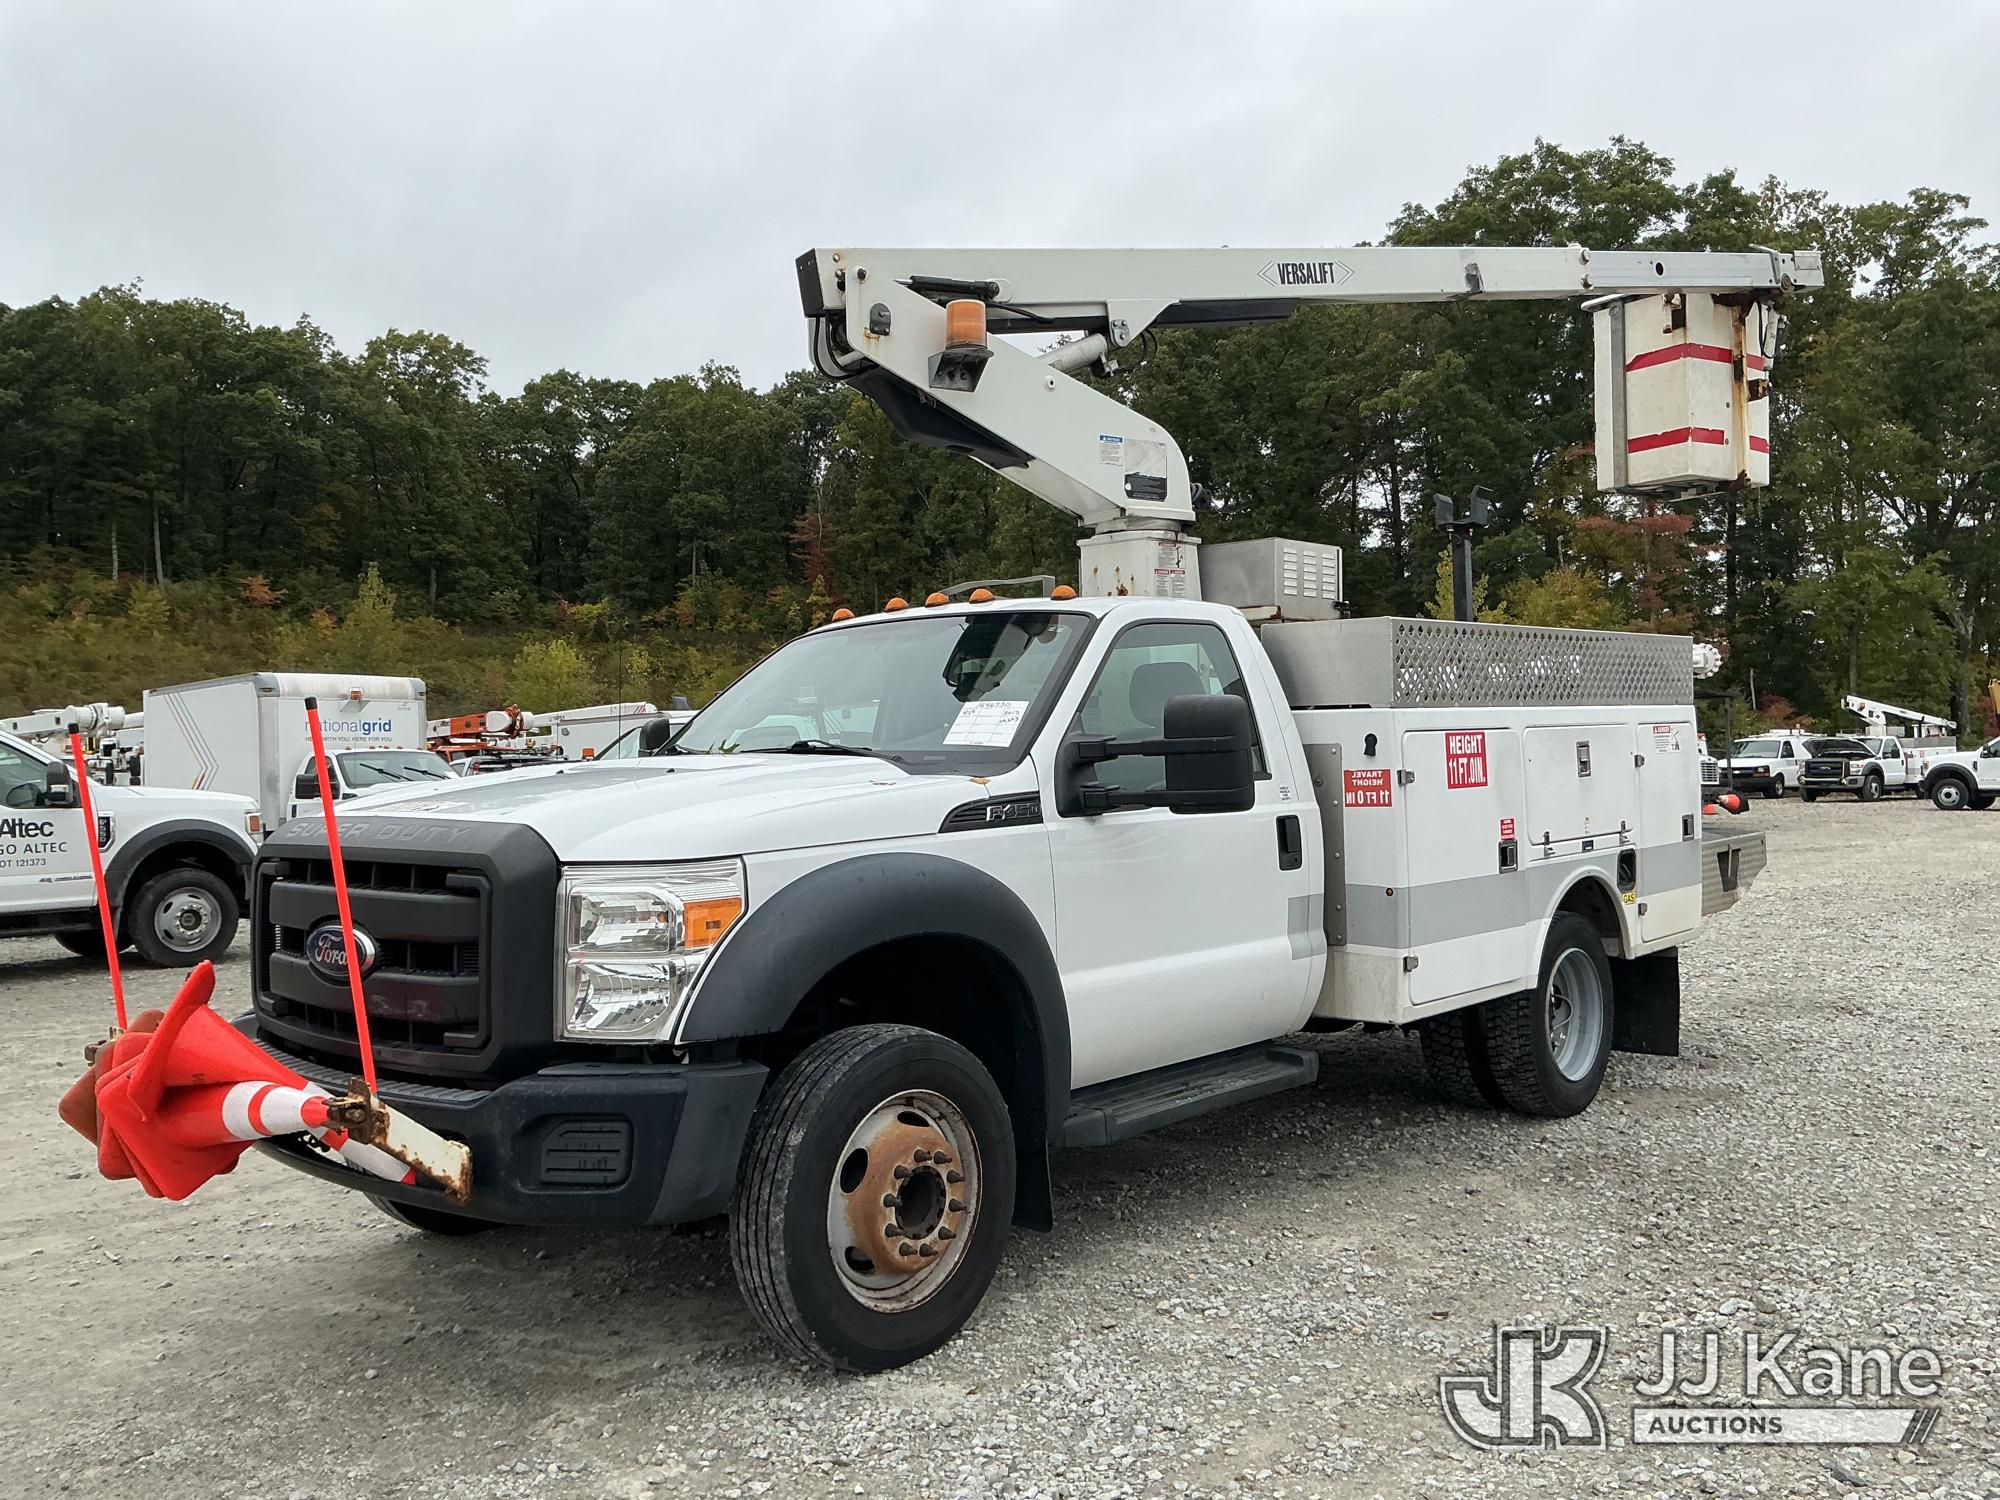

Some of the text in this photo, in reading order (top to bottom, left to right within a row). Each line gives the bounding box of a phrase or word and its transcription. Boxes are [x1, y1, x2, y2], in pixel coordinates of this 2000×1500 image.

[1277, 262, 1334, 285] VERSALIFT
[305, 717, 392, 735] tionalgrid
[1449, 735, 1482, 754] HEIGHT
[0, 818, 54, 838] Altec
[374, 824, 472, 843] DUTY
[24, 842, 67, 854] ALTEC
[16, 858, 46, 867] 121373
[1623, 894, 1635, 903] GAS
